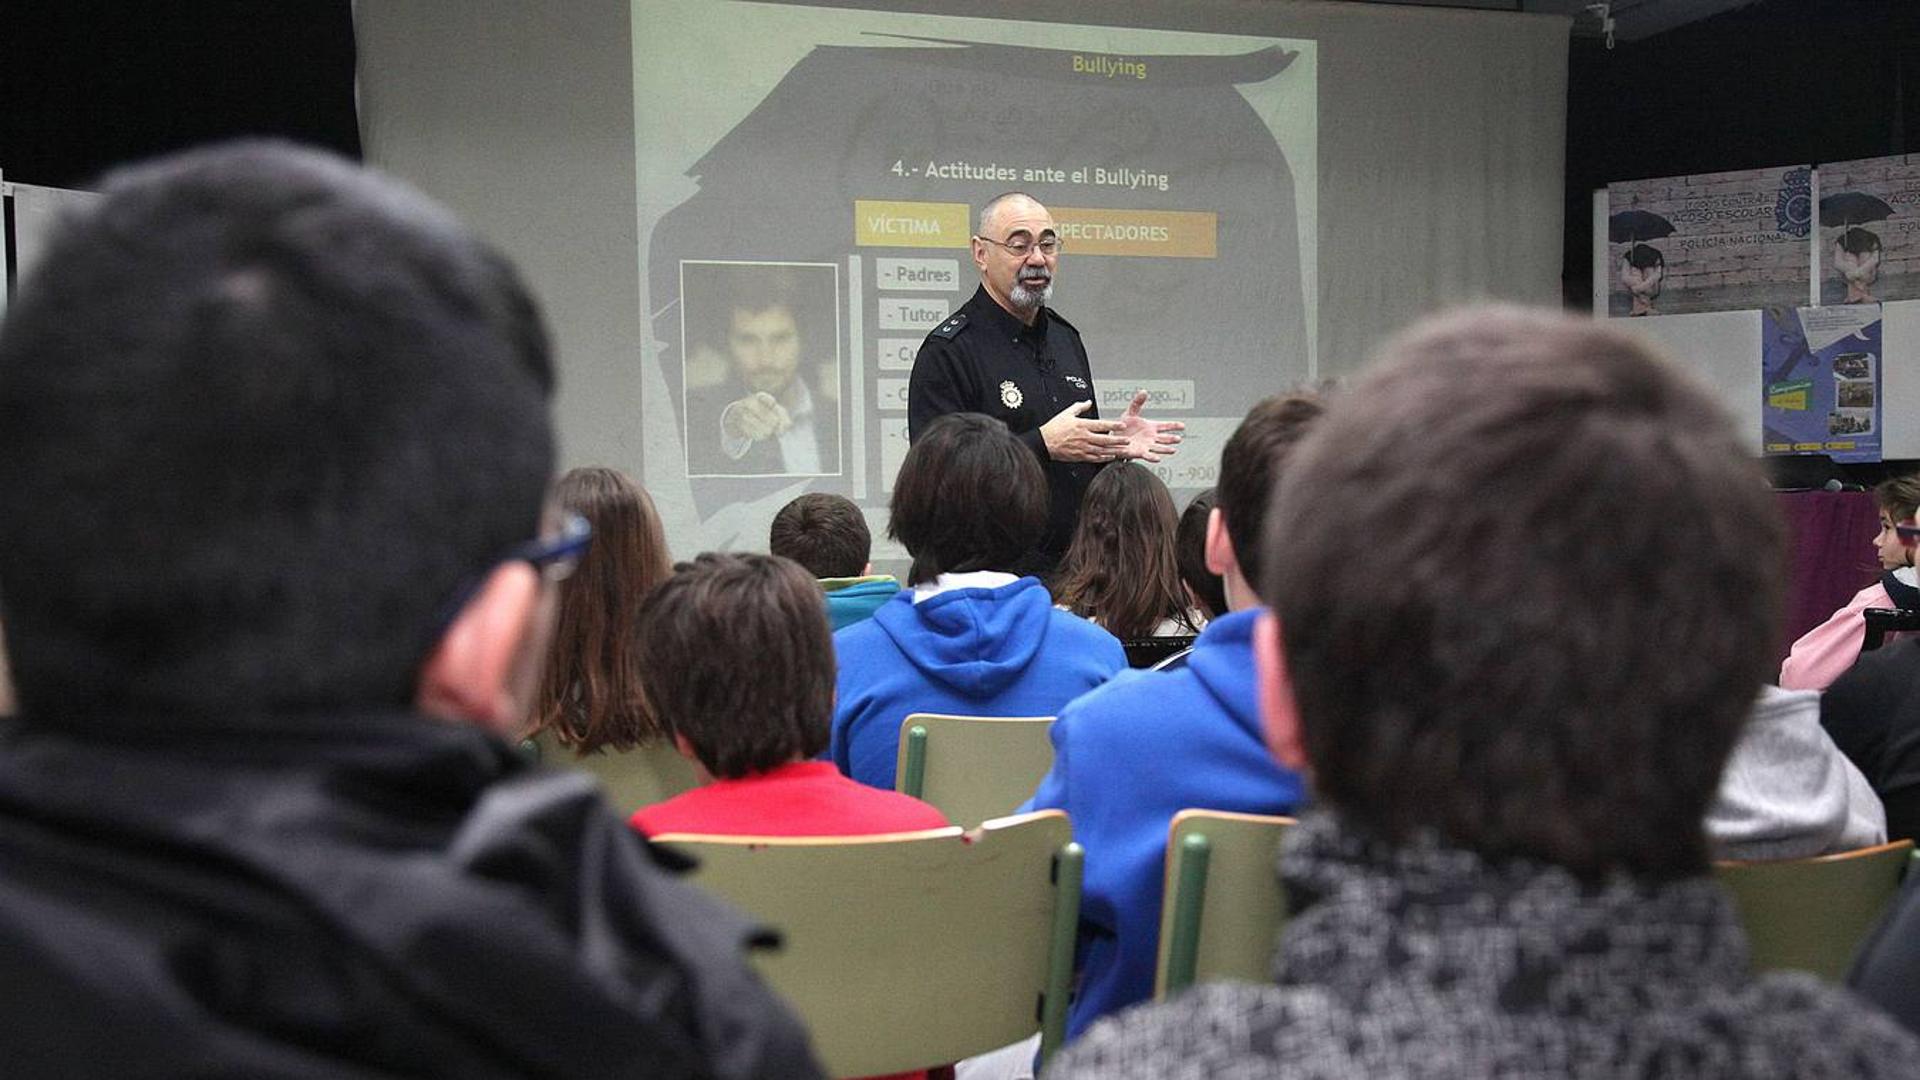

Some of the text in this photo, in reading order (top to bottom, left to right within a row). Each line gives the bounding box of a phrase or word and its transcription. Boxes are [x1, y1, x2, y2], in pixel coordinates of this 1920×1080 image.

[1073, 55, 1147, 79] Bullying
[891, 159, 1170, 192] 4.- Actitudes ante el Bullying
[867, 213, 942, 235] VÍCTIMA
[897, 265, 952, 283] Padres
[898, 306, 942, 323] Tutor
